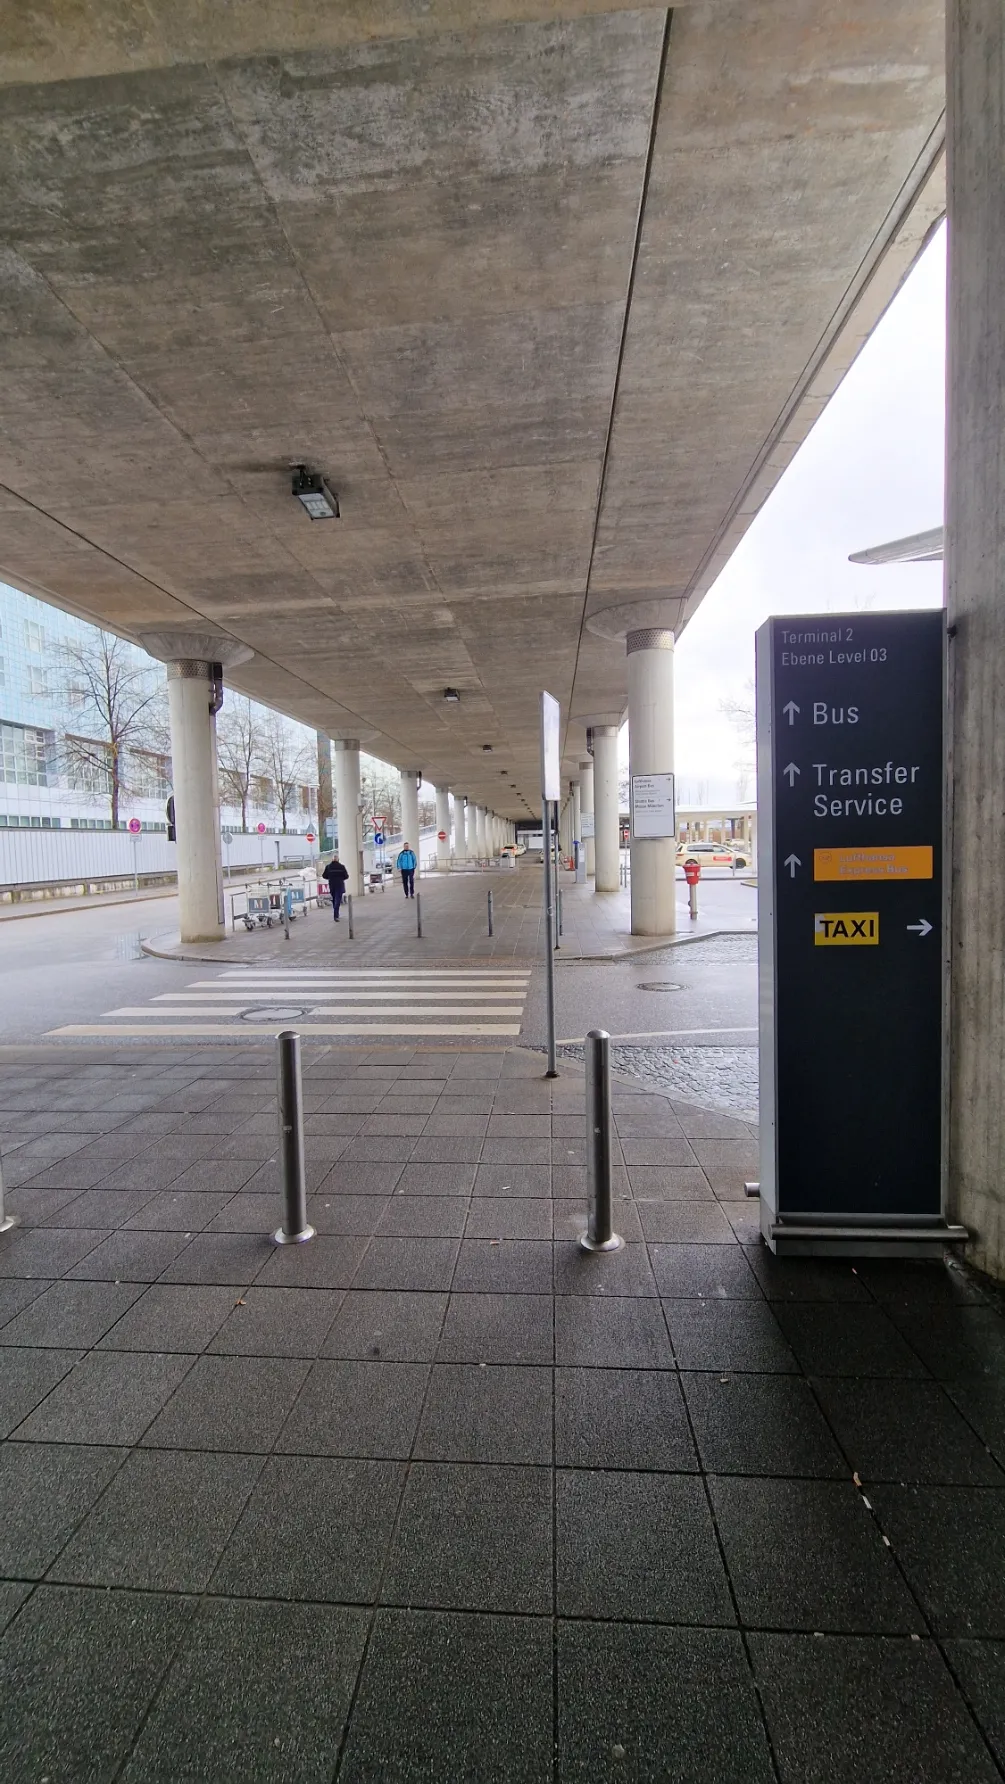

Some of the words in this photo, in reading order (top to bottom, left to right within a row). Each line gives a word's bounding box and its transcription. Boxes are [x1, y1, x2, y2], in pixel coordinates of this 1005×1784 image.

[781, 628, 841, 644] Terminal
[845, 628, 854, 642] 2
[782, 652, 824, 666] Ebene
[829, 649, 866, 664] Level
[870, 648, 887, 662] 03
[813, 702, 860, 725] Bus
[812, 762, 920, 786] Transfer
[813, 793, 903, 817] Service
[839, 852, 895, 863] Lufthansa
[886, 864, 908, 873] Bus
[819, 919, 875, 938] TAXI
